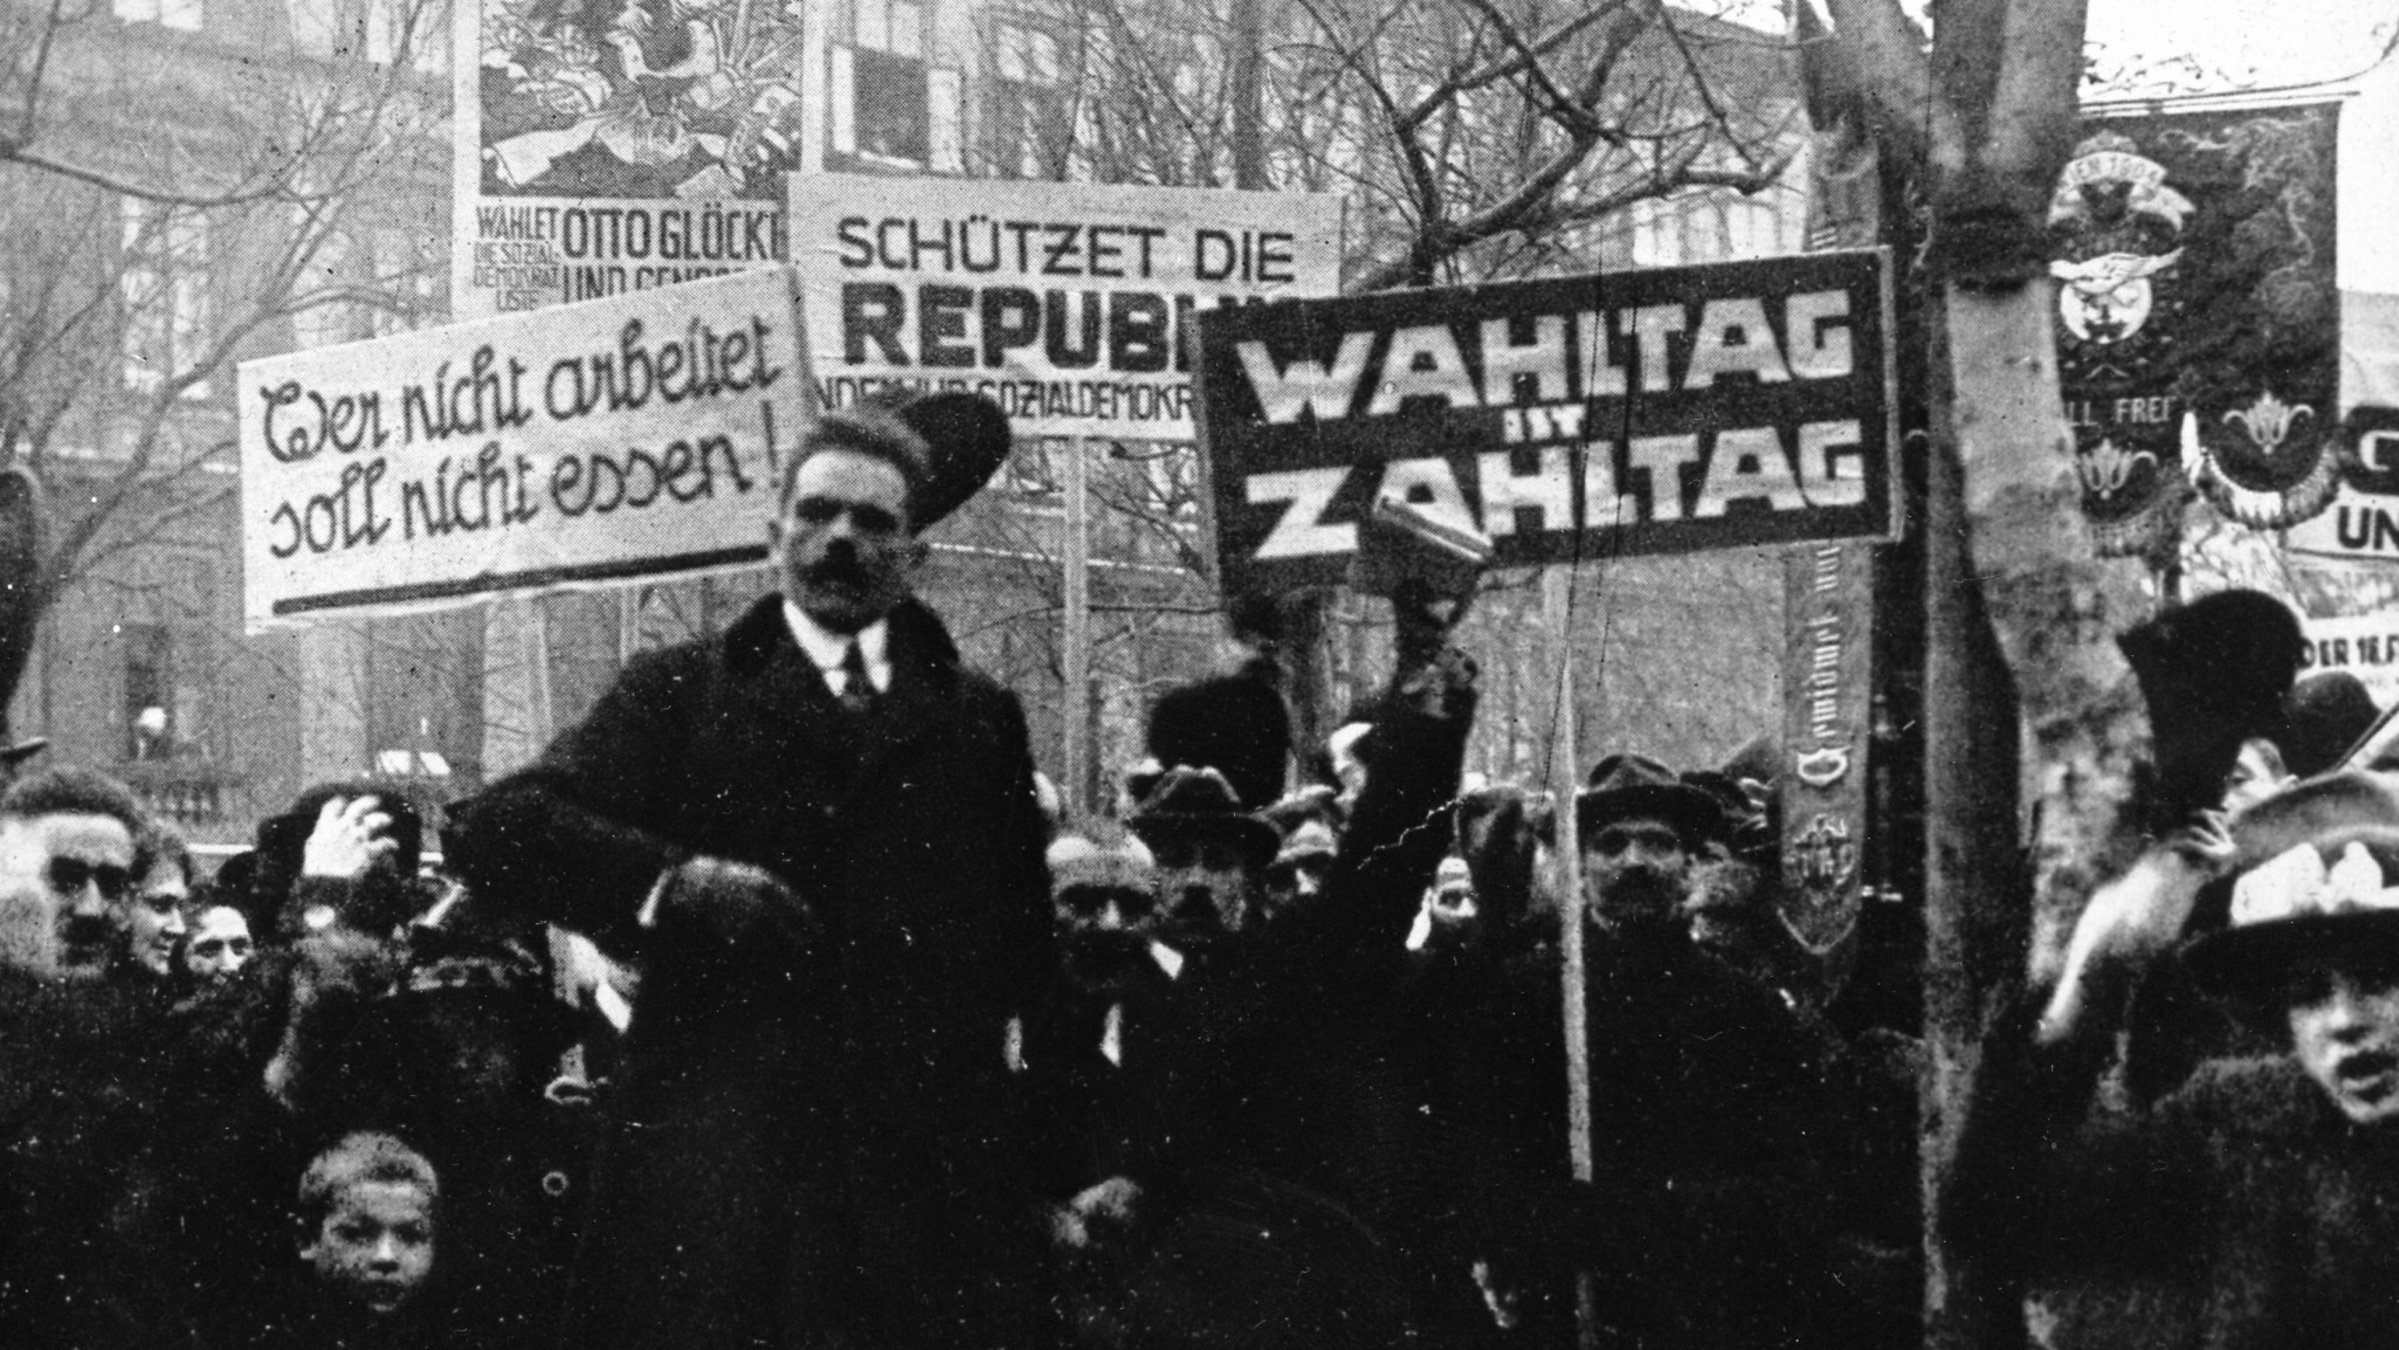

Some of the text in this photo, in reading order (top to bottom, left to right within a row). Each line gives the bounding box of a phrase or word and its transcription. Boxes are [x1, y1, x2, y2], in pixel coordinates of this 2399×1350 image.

[563, 207, 651, 258] OTTO
[838, 215, 1295, 283] SCHÜTZET DIE
[258, 313, 784, 463] Wer nicht arbeitet
[1236, 289, 1853, 424] WAHLTAG
[270, 456, 392, 559] soll
[402, 440, 538, 540] nicht
[1245, 419, 1866, 560] ZAHLTAG
